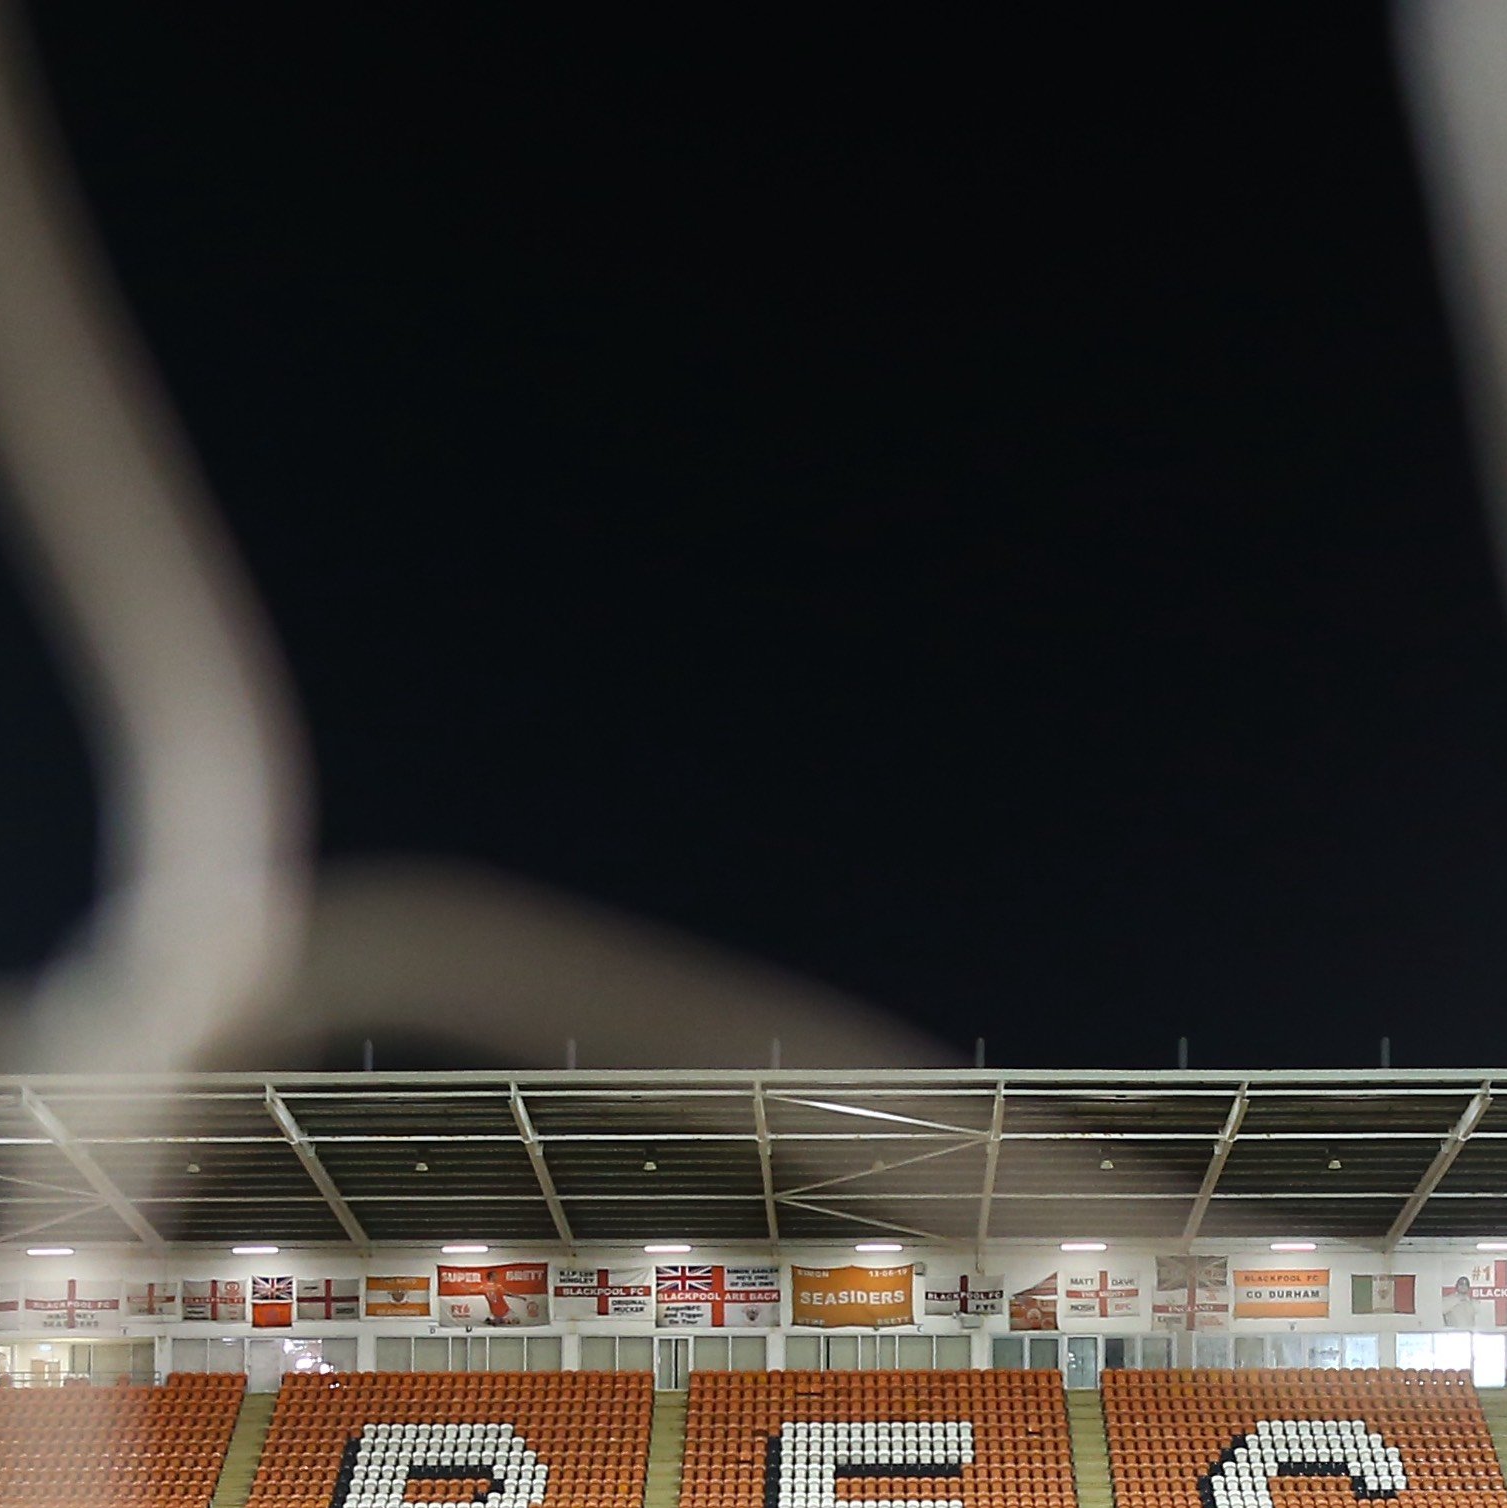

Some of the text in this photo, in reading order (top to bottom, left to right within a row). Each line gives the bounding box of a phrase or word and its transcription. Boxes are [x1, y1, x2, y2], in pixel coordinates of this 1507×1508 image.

[442, 1271, 482, 1282] SUPER
[562, 1287, 626, 1296] BLACKPOOL
[927, 1291, 988, 1300] BLACKPOOL
[1246, 1289, 1320, 1299] CO DURHAM
[657, 1292, 780, 1301] BLACKPOOL ARE BACK
[800, 1289, 905, 1306] SEASIDERS
